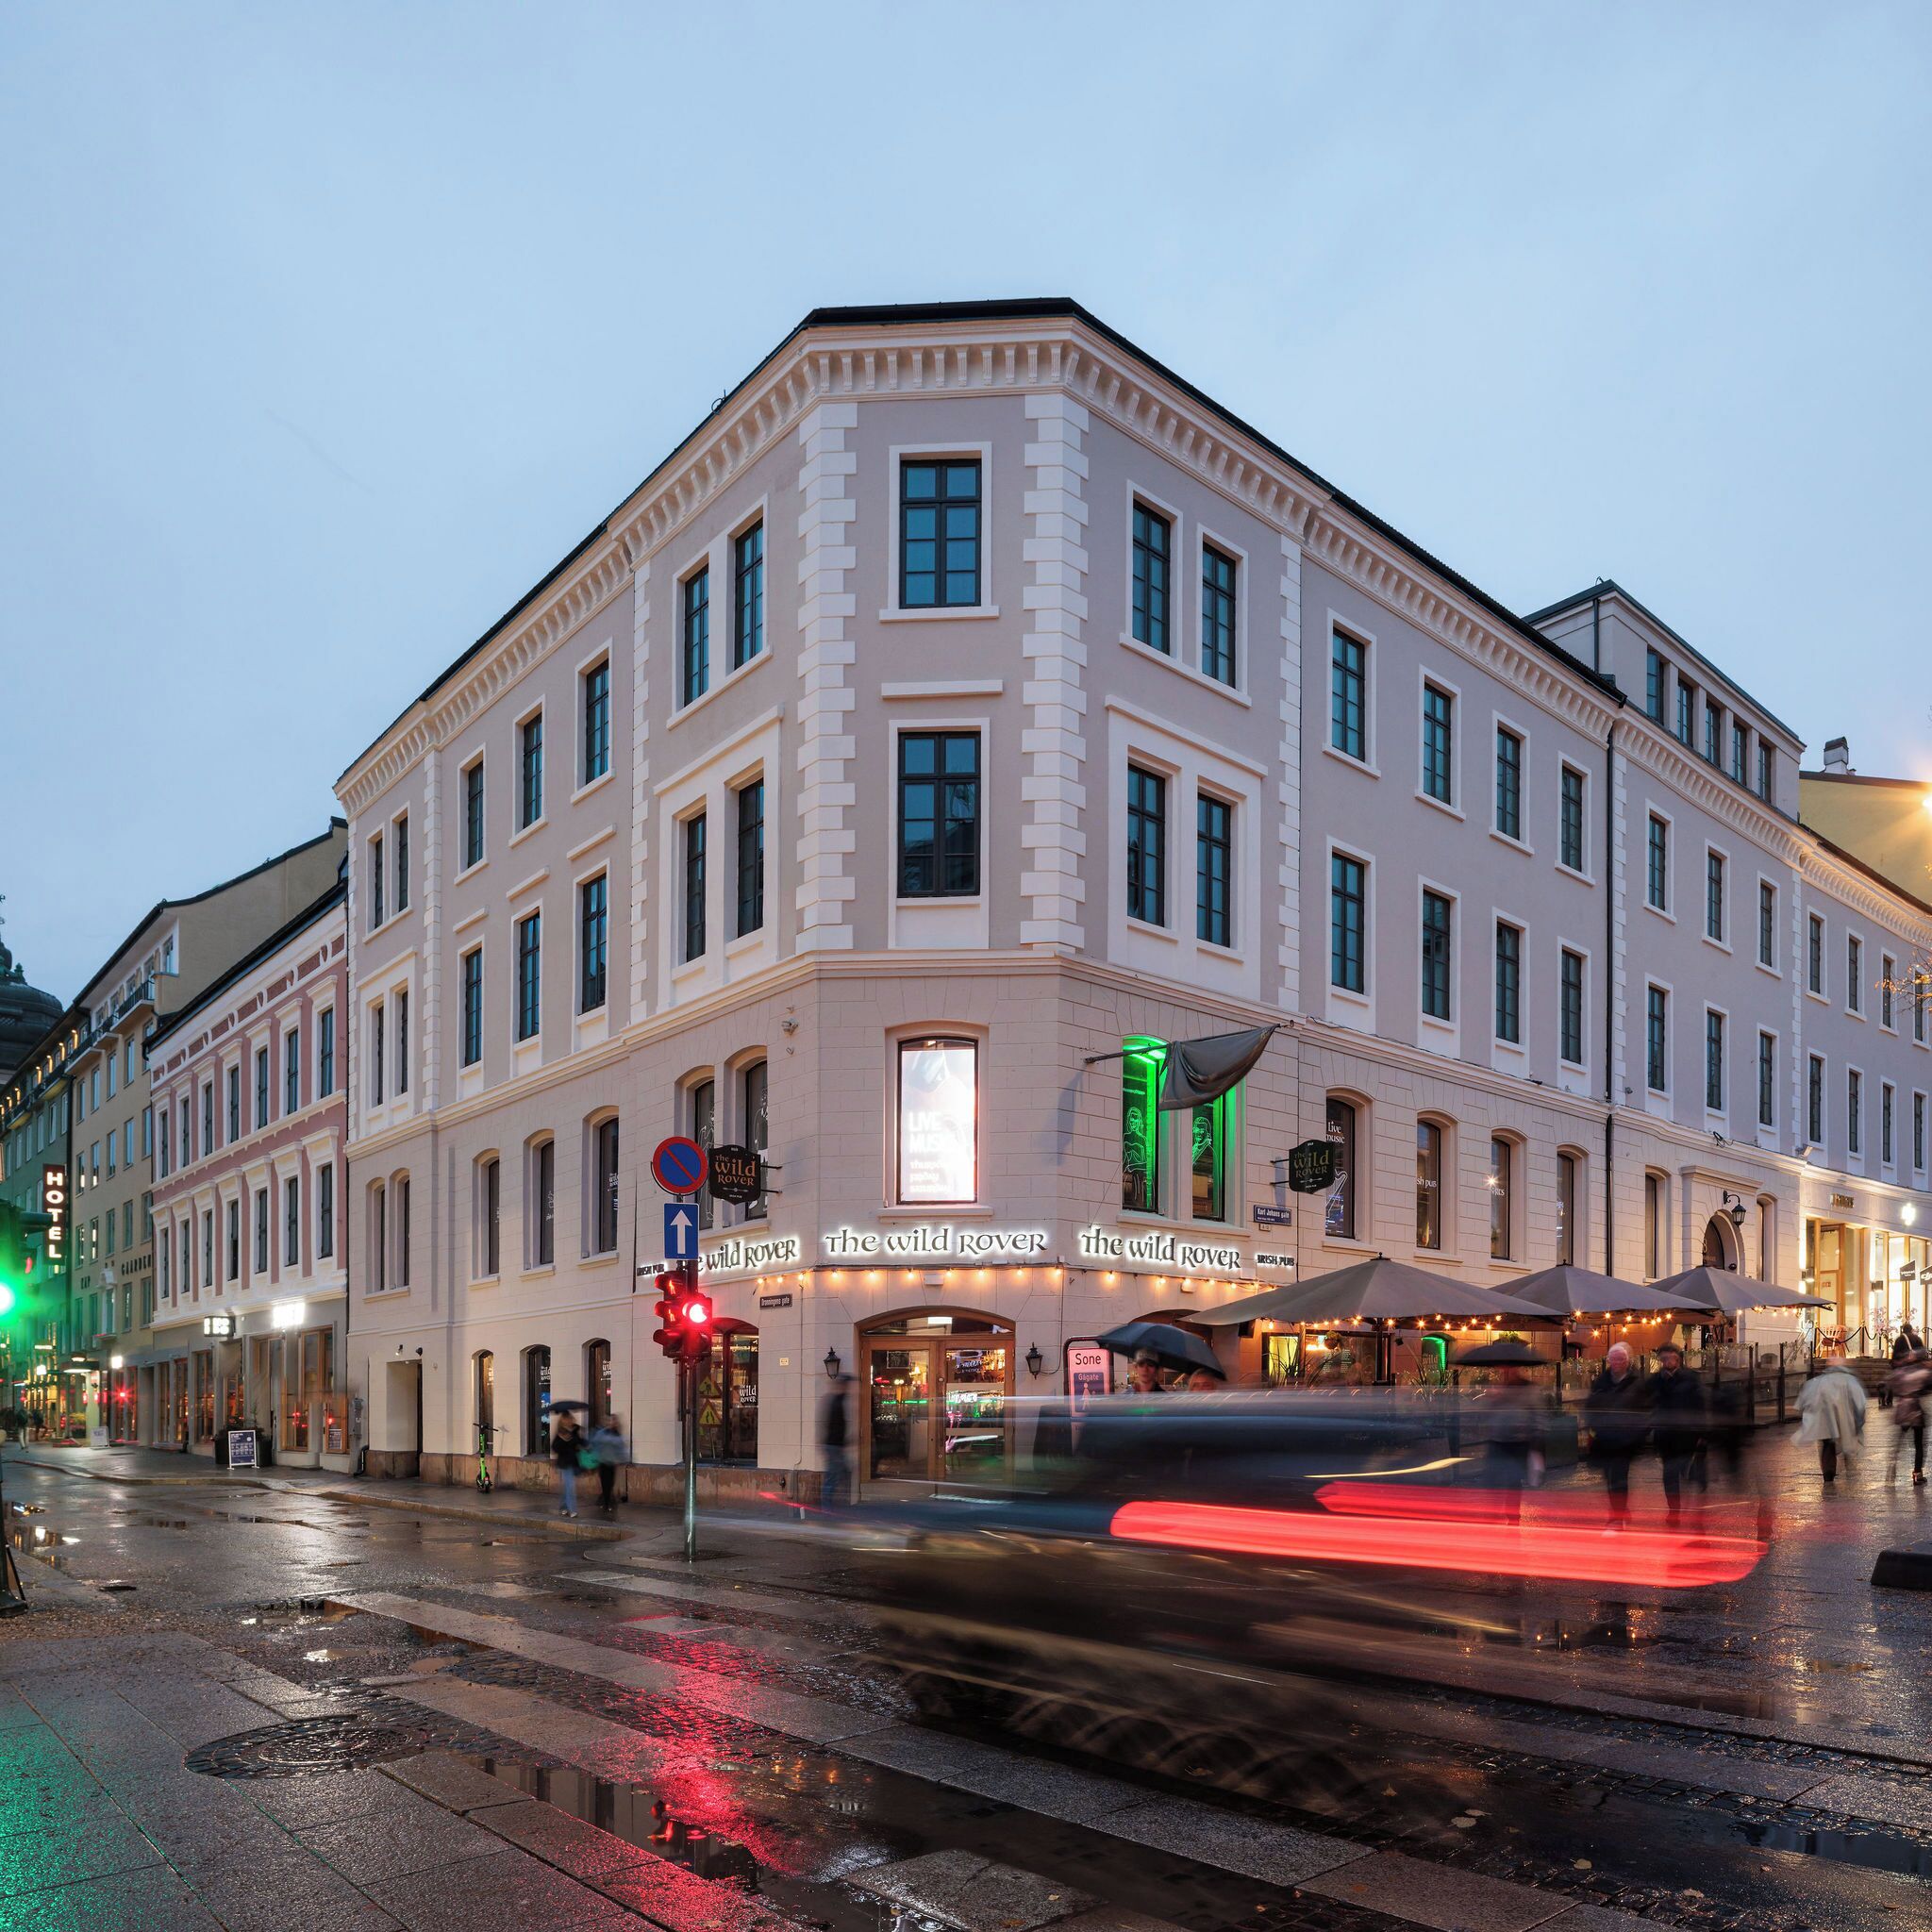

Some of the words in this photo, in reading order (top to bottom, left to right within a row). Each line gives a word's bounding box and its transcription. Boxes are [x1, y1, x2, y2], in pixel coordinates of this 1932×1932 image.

[909, 1111, 941, 1131] LIVE
[714, 1158, 756, 1176] wild
[46, 1172, 64, 1258] HOTEL
[1266, 1208, 1280, 1217] Johans
[1280, 1210, 1290, 1219] gate
[886, 1227, 950, 1252] wild
[707, 1241, 741, 1270] wild
[1128, 1235, 1176, 1261] wild
[1257, 1254, 1277, 1265] IRISH
[1279, 1256, 1294, 1267] PUB
[781, 1296, 790, 1307] gate
[1075, 1353, 1101, 1365] Sone
[1078, 1373, 1099, 1382] Gågate
[740, 1385, 757, 1396] wild
